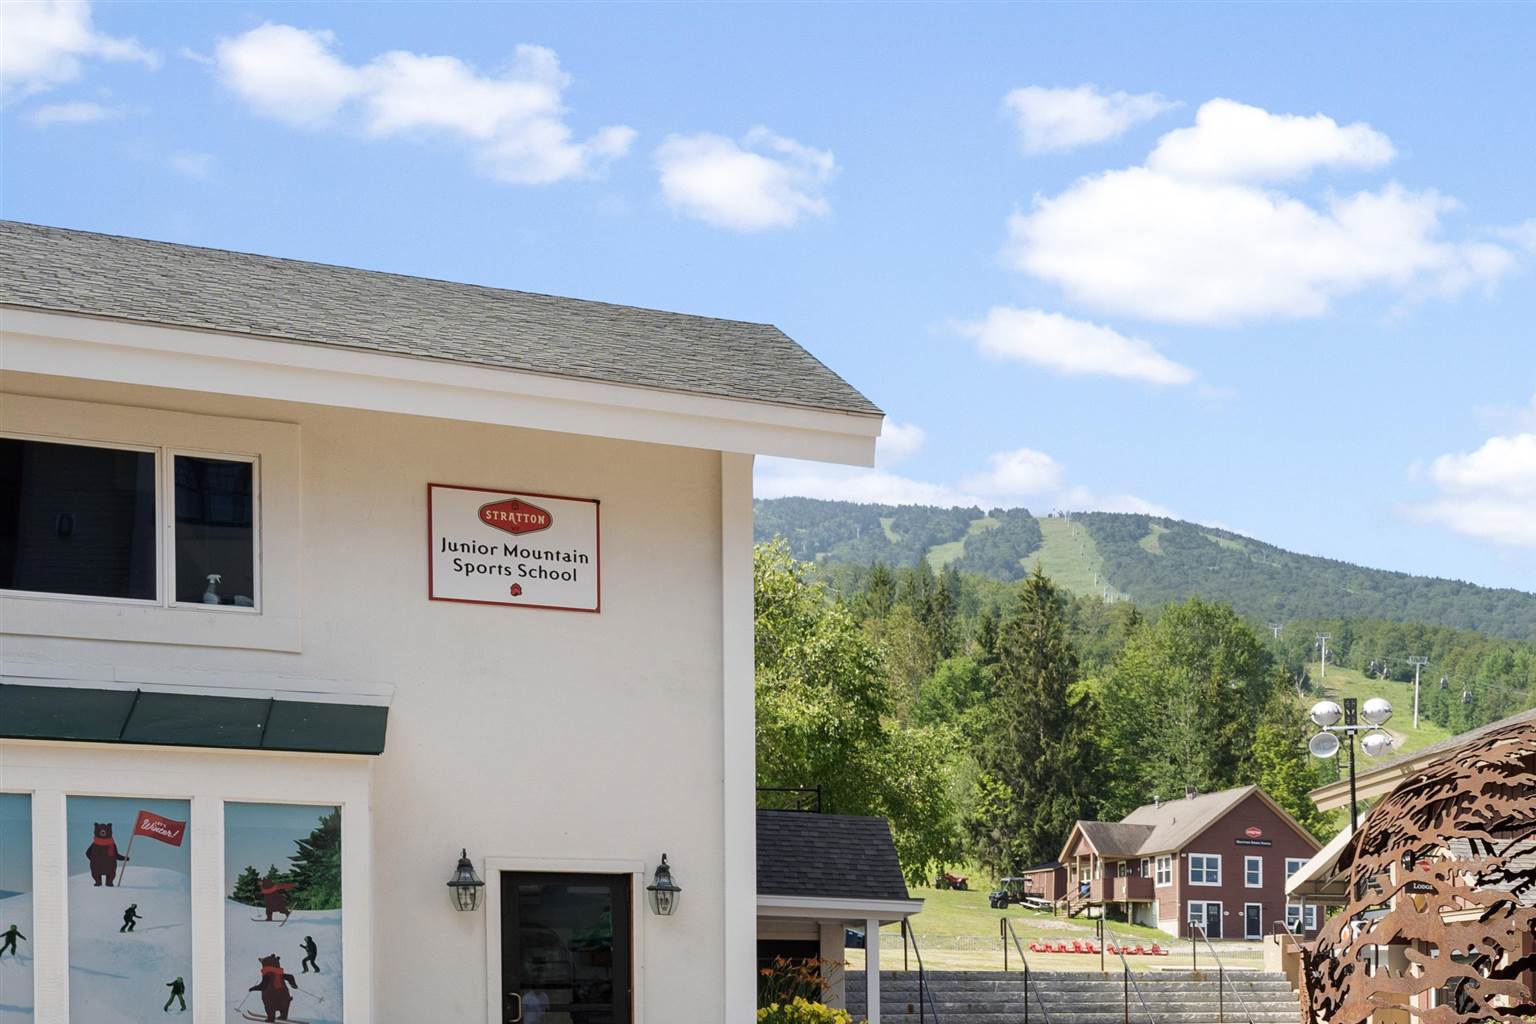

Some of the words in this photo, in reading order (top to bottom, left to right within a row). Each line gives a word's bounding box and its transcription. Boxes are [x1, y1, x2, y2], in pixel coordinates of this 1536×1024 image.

[485, 510, 545, 525] STRATTON
[441, 537, 498, 556] Junior
[504, 543, 589, 564] Mountain
[453, 557, 512, 577] Sports
[518, 563, 577, 582] School
